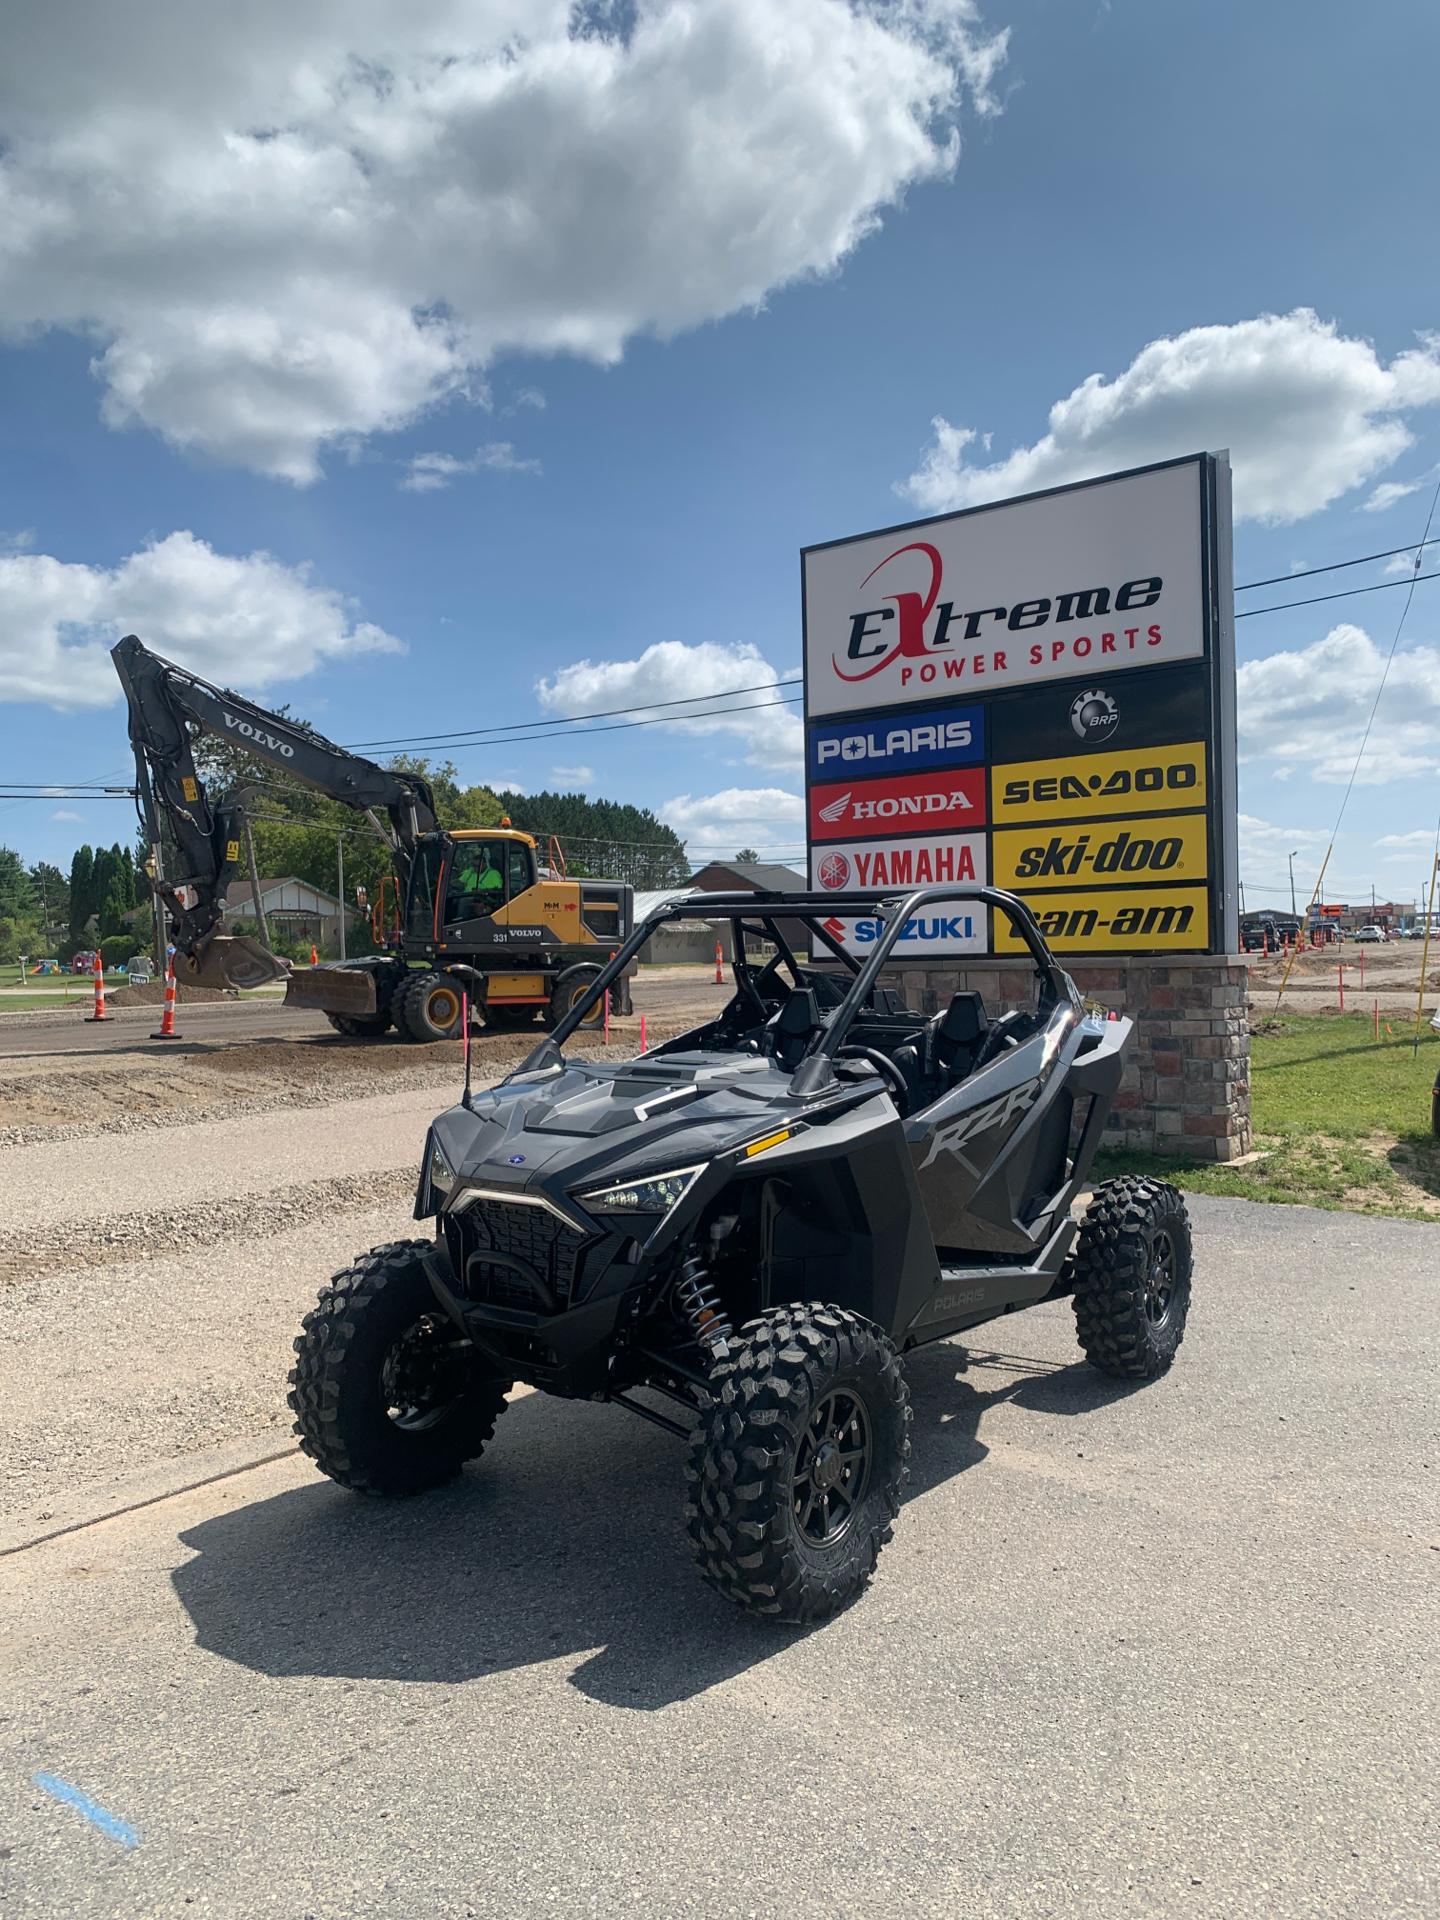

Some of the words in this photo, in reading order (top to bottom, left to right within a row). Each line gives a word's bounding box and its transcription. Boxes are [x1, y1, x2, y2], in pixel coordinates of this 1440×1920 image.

[901, 650, 1007, 686] POWER
[1029, 624, 1162, 665] SPORTS
[222, 711, 295, 757] VOLVO
[1089, 713, 1118, 727] BRP
[817, 720, 972, 764] POLARIS
[852, 791, 973, 819] HONDA
[853, 845, 976, 887] YAMAHA
[1014, 832, 1184, 878] ski-doo
[493, 934, 508, 942] 331
[509, 929, 542, 937] VOLVO
[917, 1078, 1036, 1171] RZR
[934, 1288, 986, 1312] POLARIS
